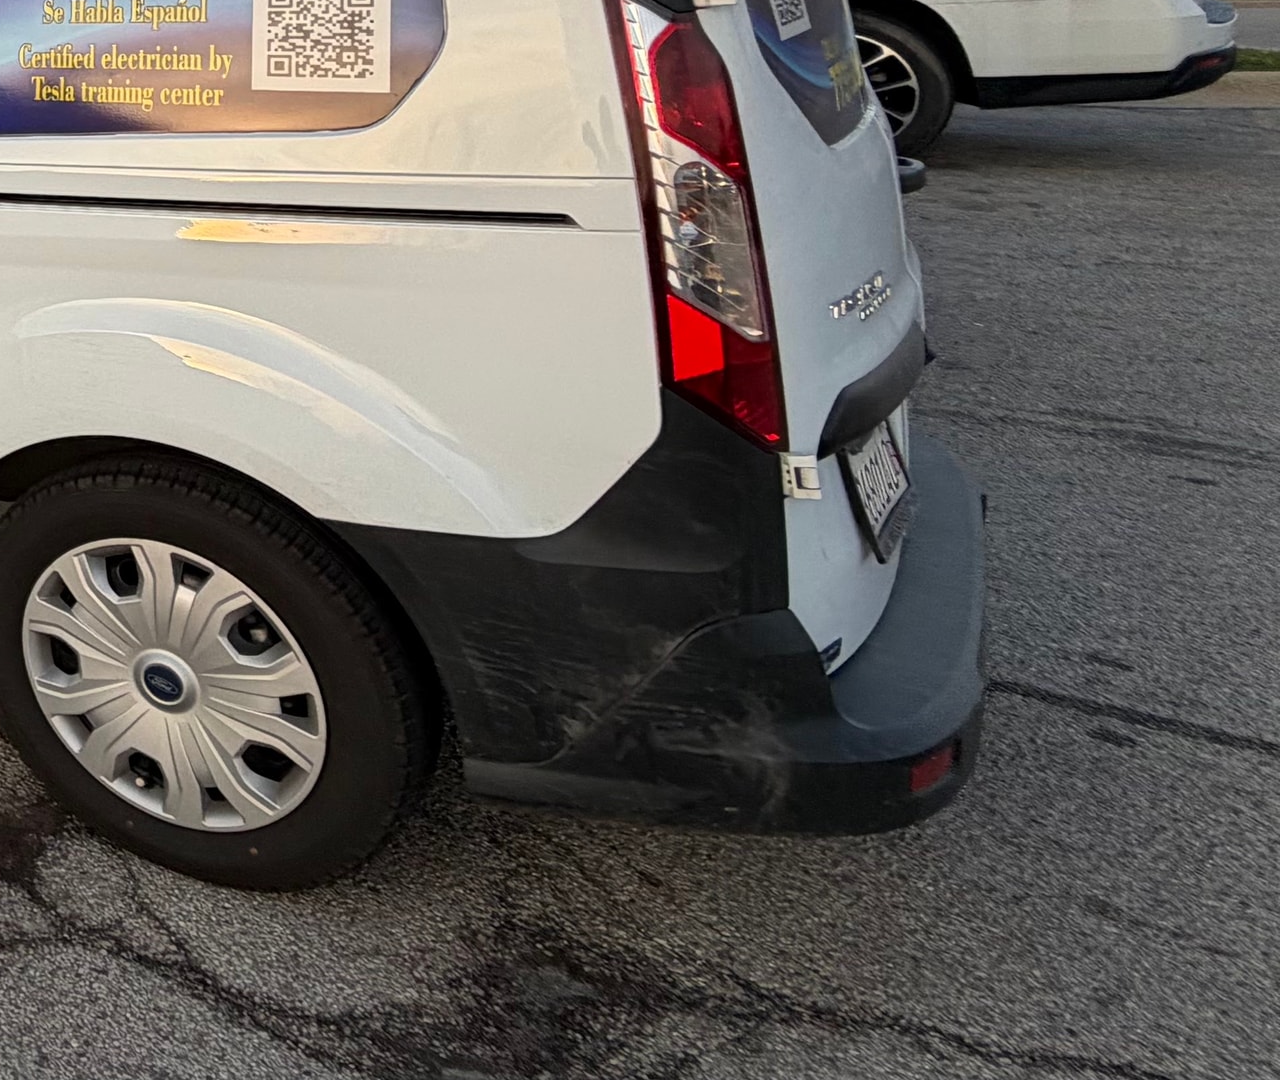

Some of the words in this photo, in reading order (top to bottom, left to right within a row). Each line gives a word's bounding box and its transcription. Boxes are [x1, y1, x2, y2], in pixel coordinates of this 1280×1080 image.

[18, 42, 95, 69] Certified
[101, 44, 202, 71] electrician
[208, 44, 233, 79] by
[32, 75, 74, 103] Tesla
[81, 78, 154, 112] training
[160, 82, 225, 106] center
